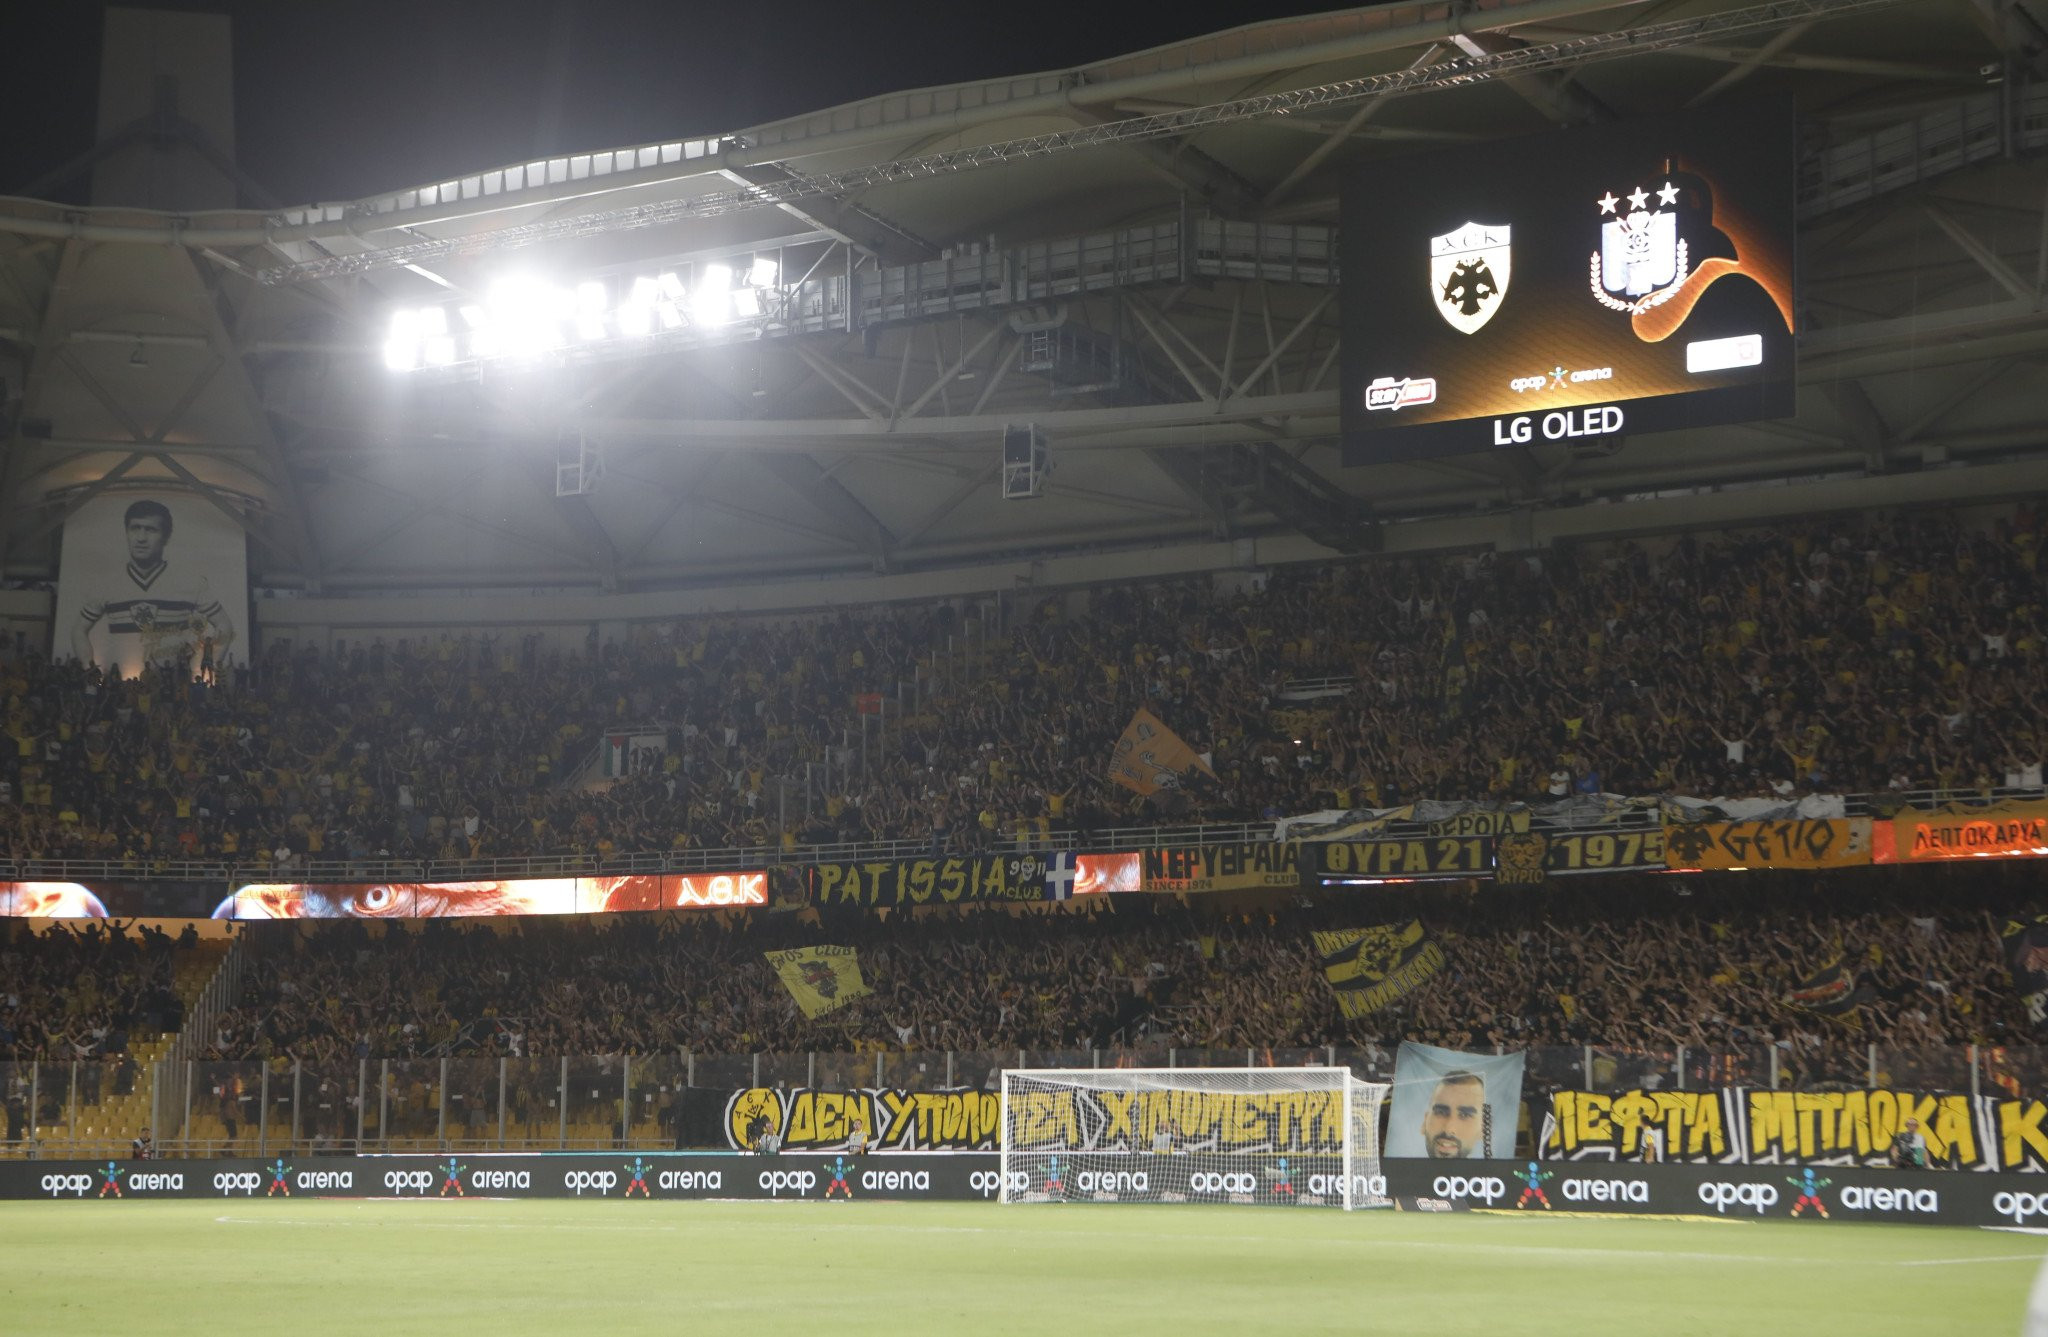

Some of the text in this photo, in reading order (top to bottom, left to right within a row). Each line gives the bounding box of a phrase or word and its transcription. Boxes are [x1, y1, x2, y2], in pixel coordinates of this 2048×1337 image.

[1510, 366, 1612, 392] opap arena
[1494, 406, 1624, 446] LG OLED
[1437, 839, 1482, 870] 21
[1561, 832, 1665, 868] 1975
[818, 856, 1005, 906] PATISSIA
[1146, 879, 1213, 891] SINCE 1974
[1264, 874, 1299, 885] CLUB
[1007, 886, 1042, 902] CLUB
[41, 1172, 183, 1196] opap arena
[214, 1171, 353, 1195] opap arena
[384, 1169, 530, 1193] opap arena
[565, 1170, 722, 1194] opap arena
[759, 1170, 929, 1196] opap arena
[970, 1170, 1148, 1197] opap arena
[1308, 1173, 1387, 1195] arena
[1433, 1175, 1505, 1205] opap
[1562, 1178, 1649, 1203] arena
[1698, 1182, 1938, 1214] opap arena
